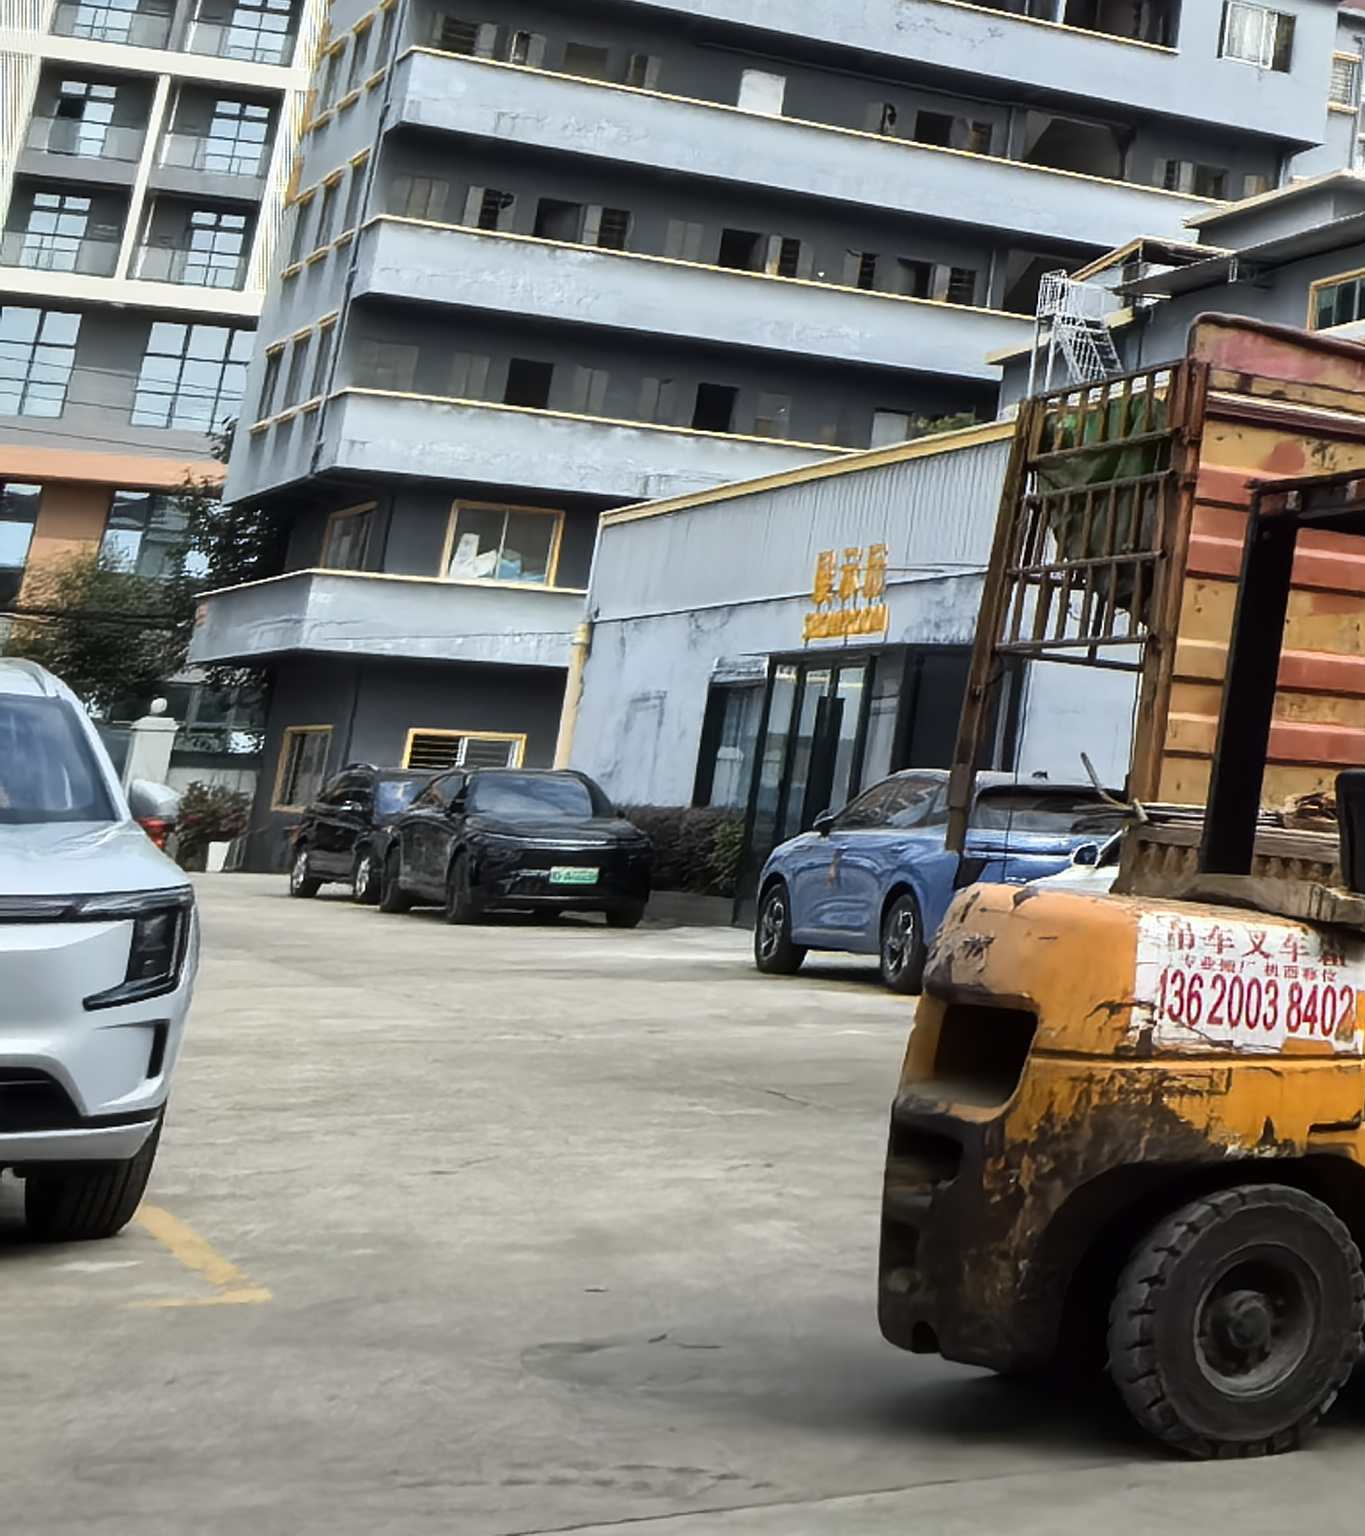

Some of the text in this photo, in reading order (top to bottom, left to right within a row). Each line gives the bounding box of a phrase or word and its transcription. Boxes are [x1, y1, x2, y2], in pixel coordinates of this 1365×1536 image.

[1158, 966, 1355, 1040] 136 2003 8402
